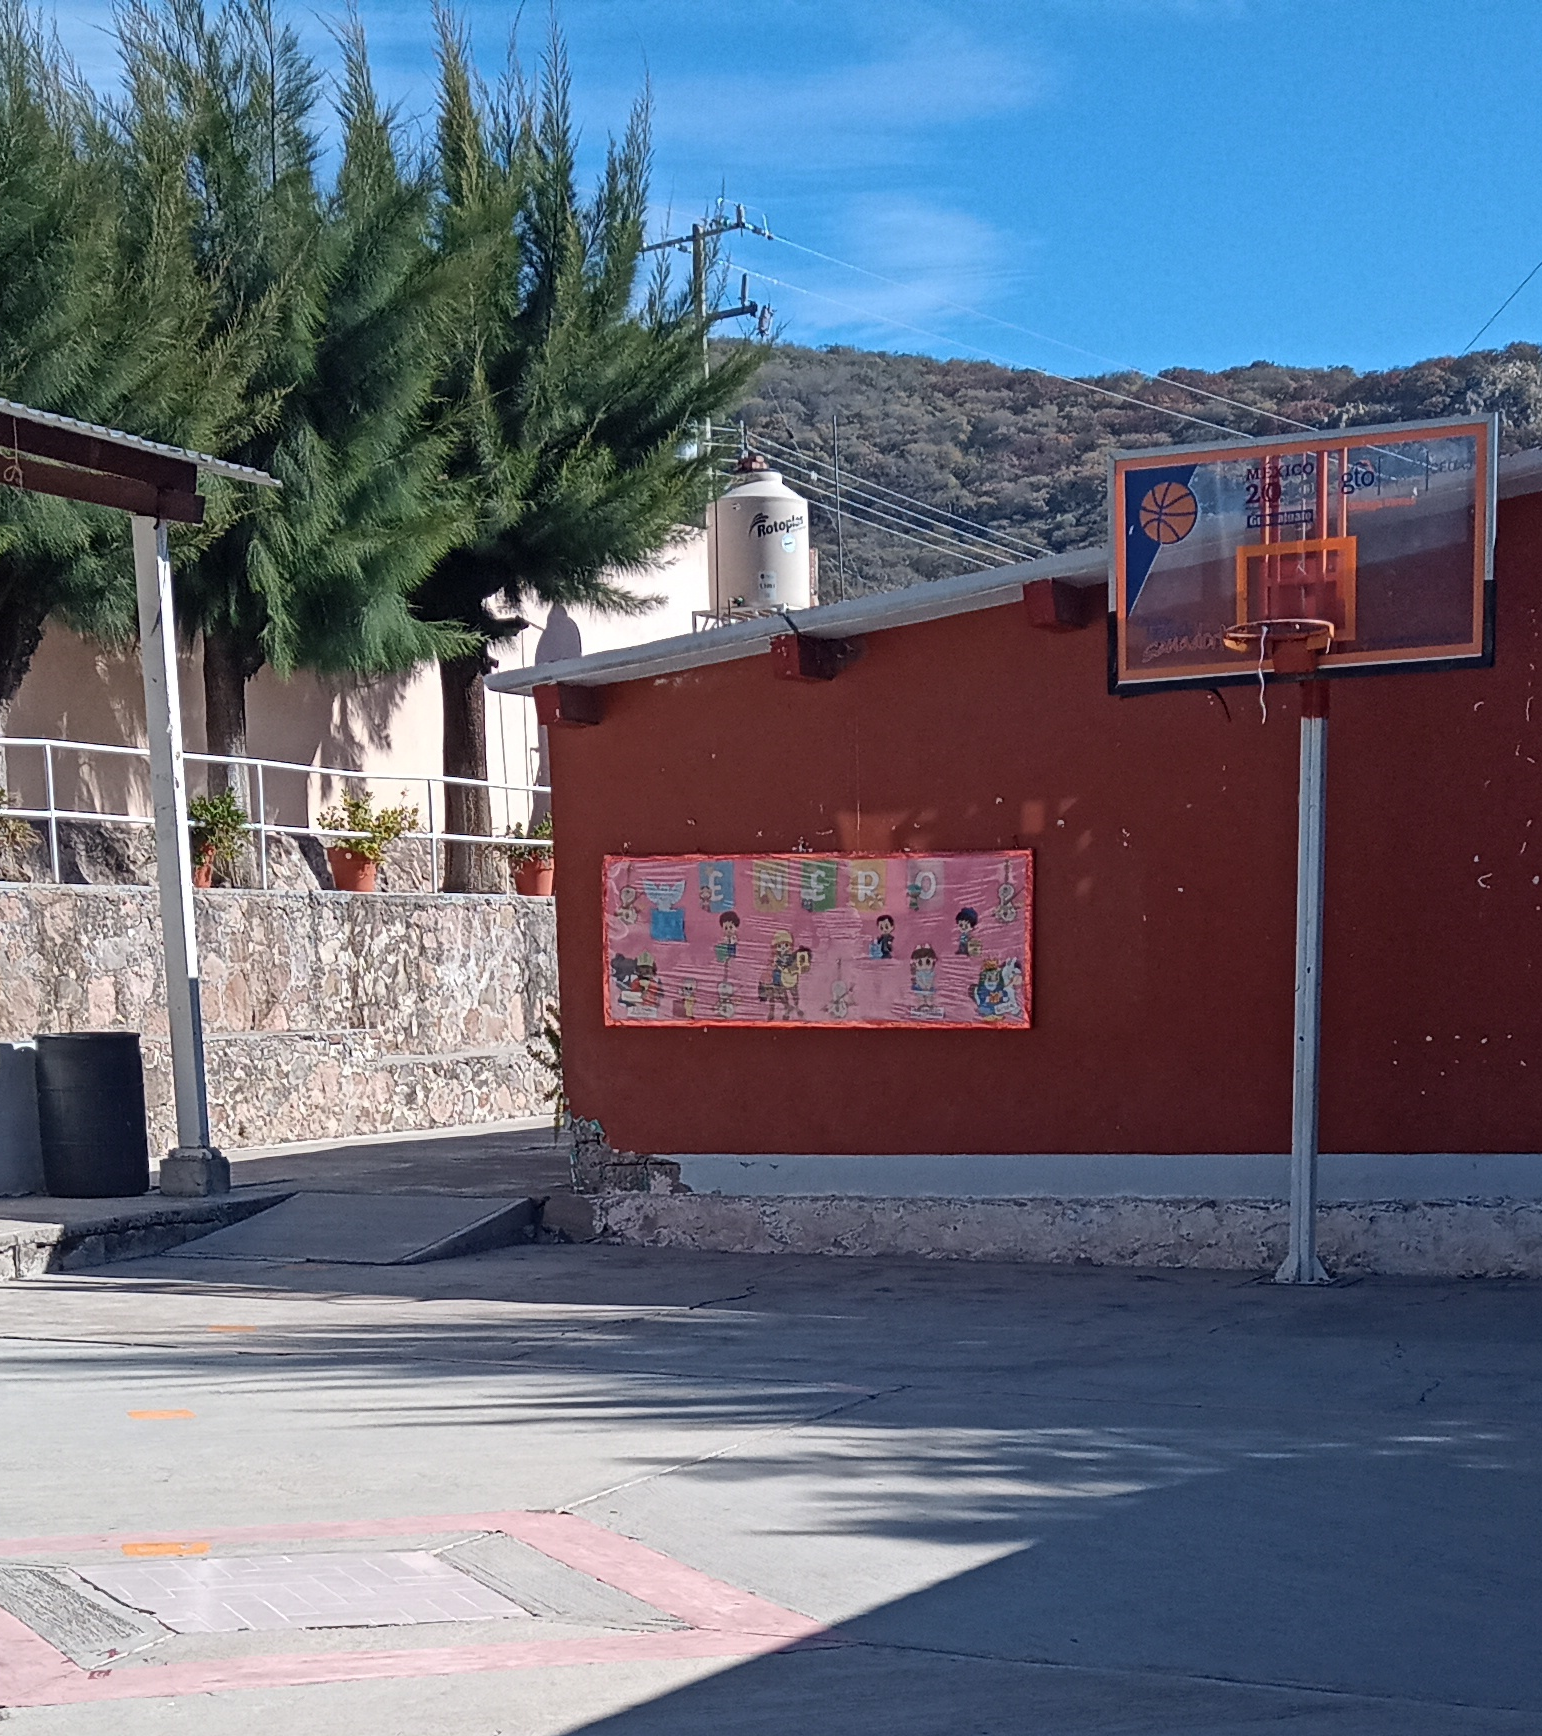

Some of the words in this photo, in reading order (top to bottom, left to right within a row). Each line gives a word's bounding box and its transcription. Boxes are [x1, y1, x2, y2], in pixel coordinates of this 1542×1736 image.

[1341, 467, 1375, 495] gto
[757, 515, 803, 538] Rotoplas
[709, 869, 937, 902] ENERO
